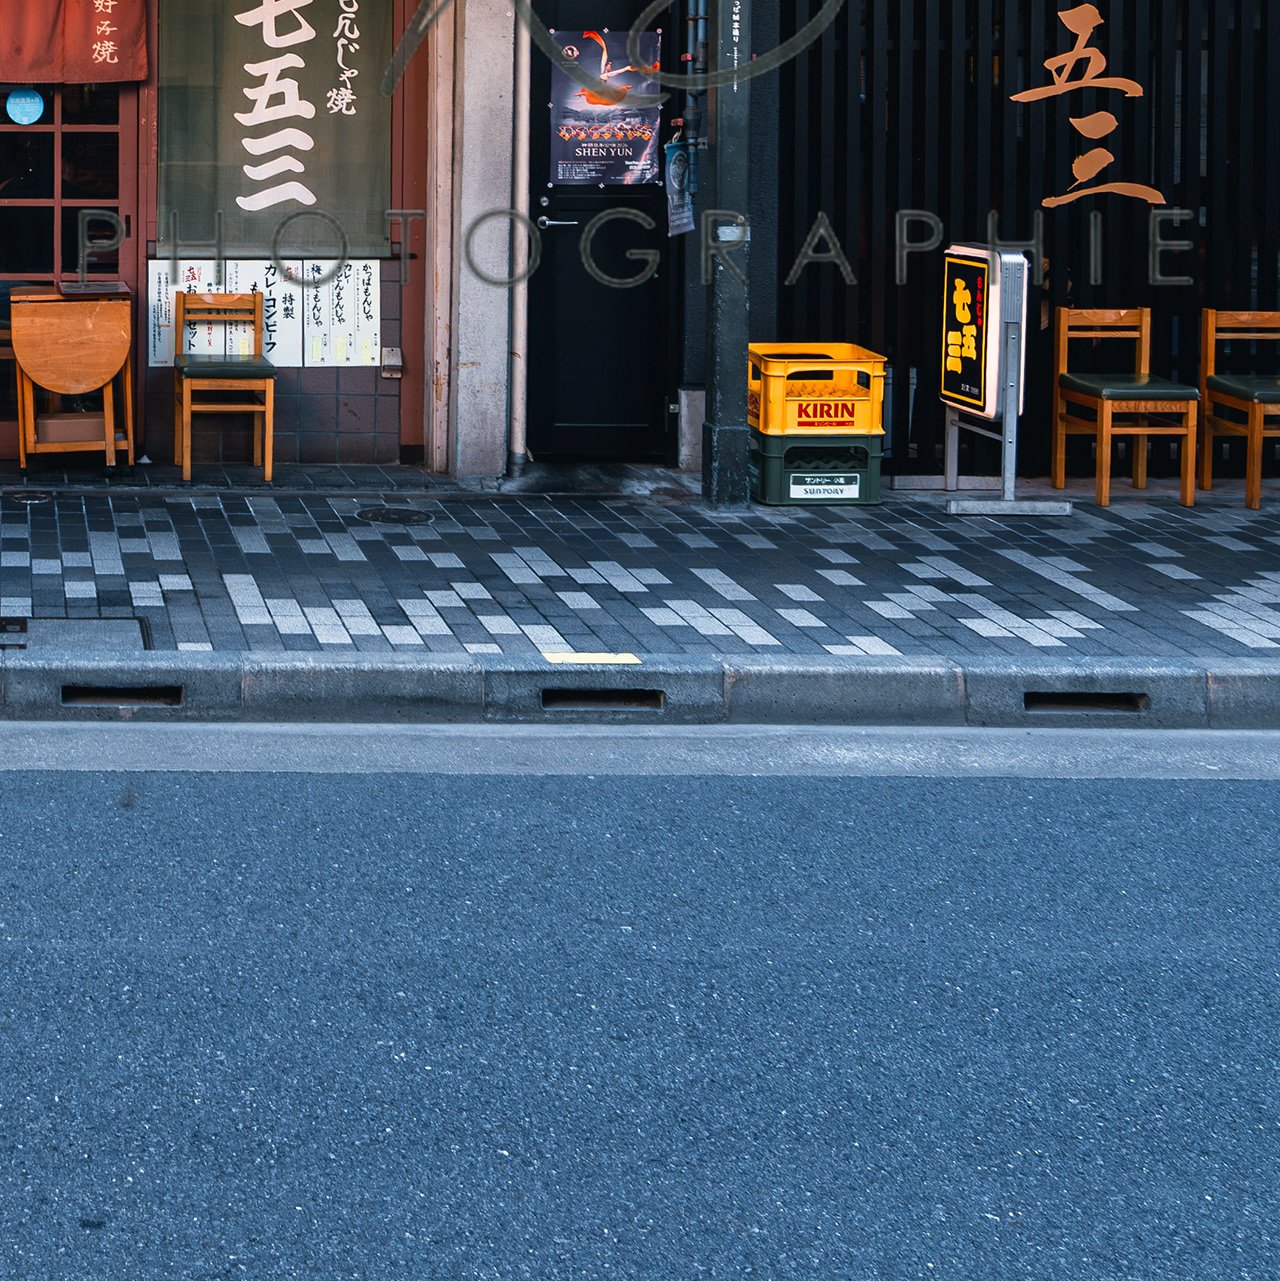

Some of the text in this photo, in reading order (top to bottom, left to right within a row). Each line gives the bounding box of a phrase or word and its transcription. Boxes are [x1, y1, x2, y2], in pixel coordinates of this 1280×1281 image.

[575, 148, 633, 157] SHEN YUN
[264, 263, 277, 353] カレーコンビーフ
[281, 292, 296, 320] 特製
[797, 403, 855, 418] KIRIN
